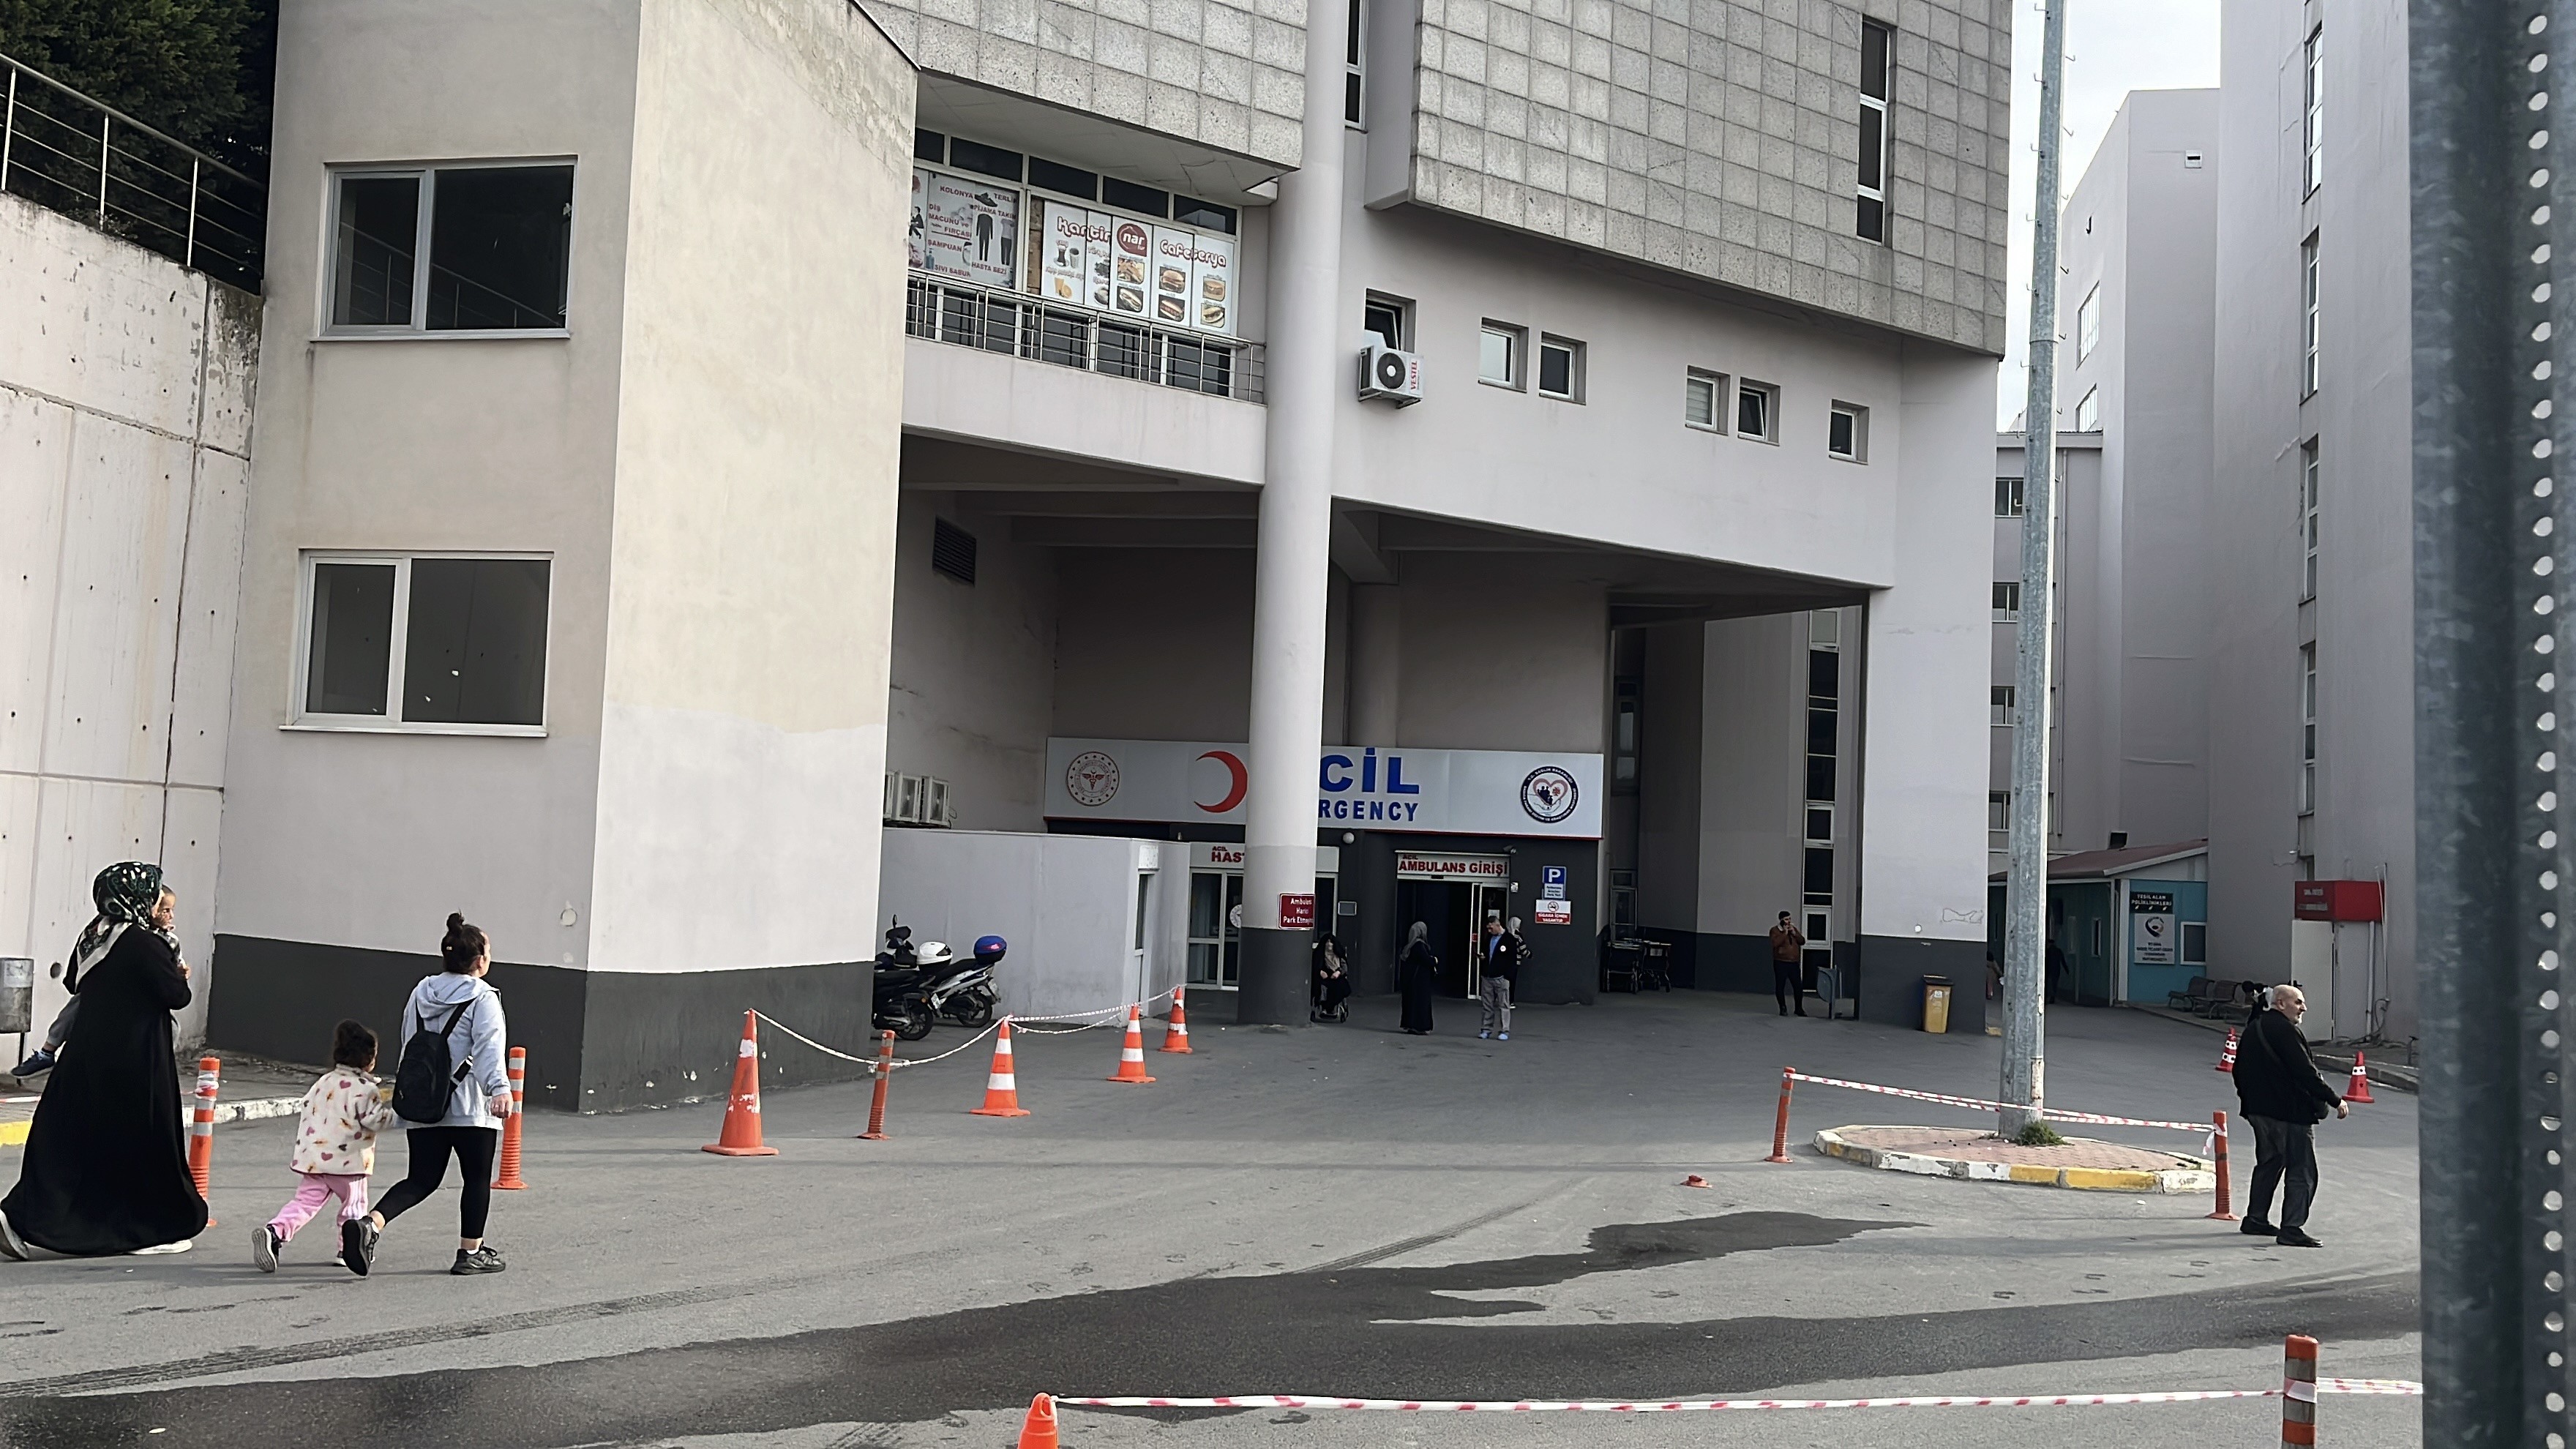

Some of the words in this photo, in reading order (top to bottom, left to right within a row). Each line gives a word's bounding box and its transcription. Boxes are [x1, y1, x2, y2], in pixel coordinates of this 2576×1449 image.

[940, 185, 973, 199] KOLONYA
[1123, 231, 1145, 245] nar
[1159, 239, 1227, 269] Cafeterya
[971, 261, 992, 272] HASTA
[1319, 747, 1420, 794] CİL
[1318, 798, 1418, 822] RGENCY
[1399, 861, 1466, 873] AMBULANS
[1469, 860, 1508, 877] GİRİŞİ
[1548, 869, 1561, 883] P
[1283, 916, 1296, 924] Park
